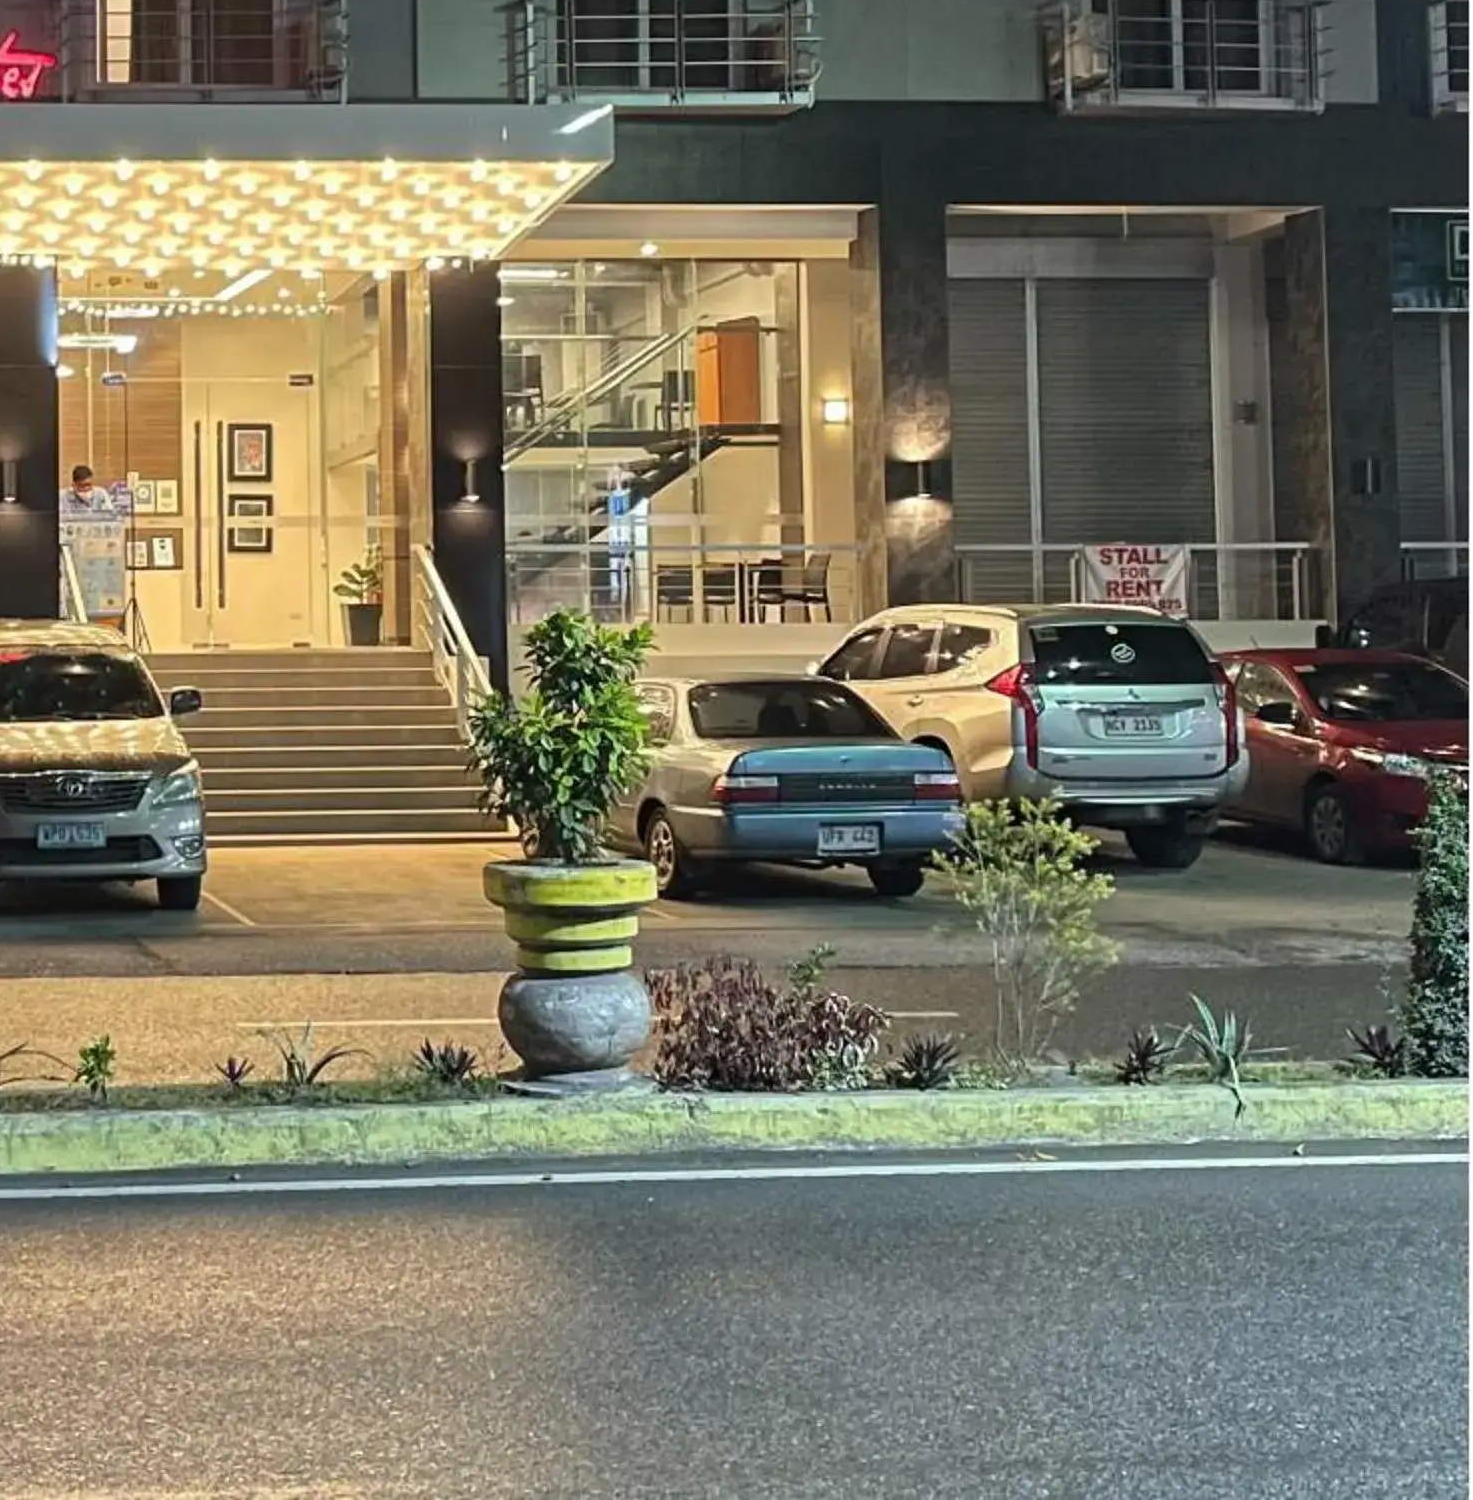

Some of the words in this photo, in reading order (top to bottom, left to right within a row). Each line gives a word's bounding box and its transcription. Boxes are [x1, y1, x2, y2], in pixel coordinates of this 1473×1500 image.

[1098, 547, 1169, 565] STALL
[1119, 567, 1150, 578] FOR
[1106, 580, 1164, 598] RENT
